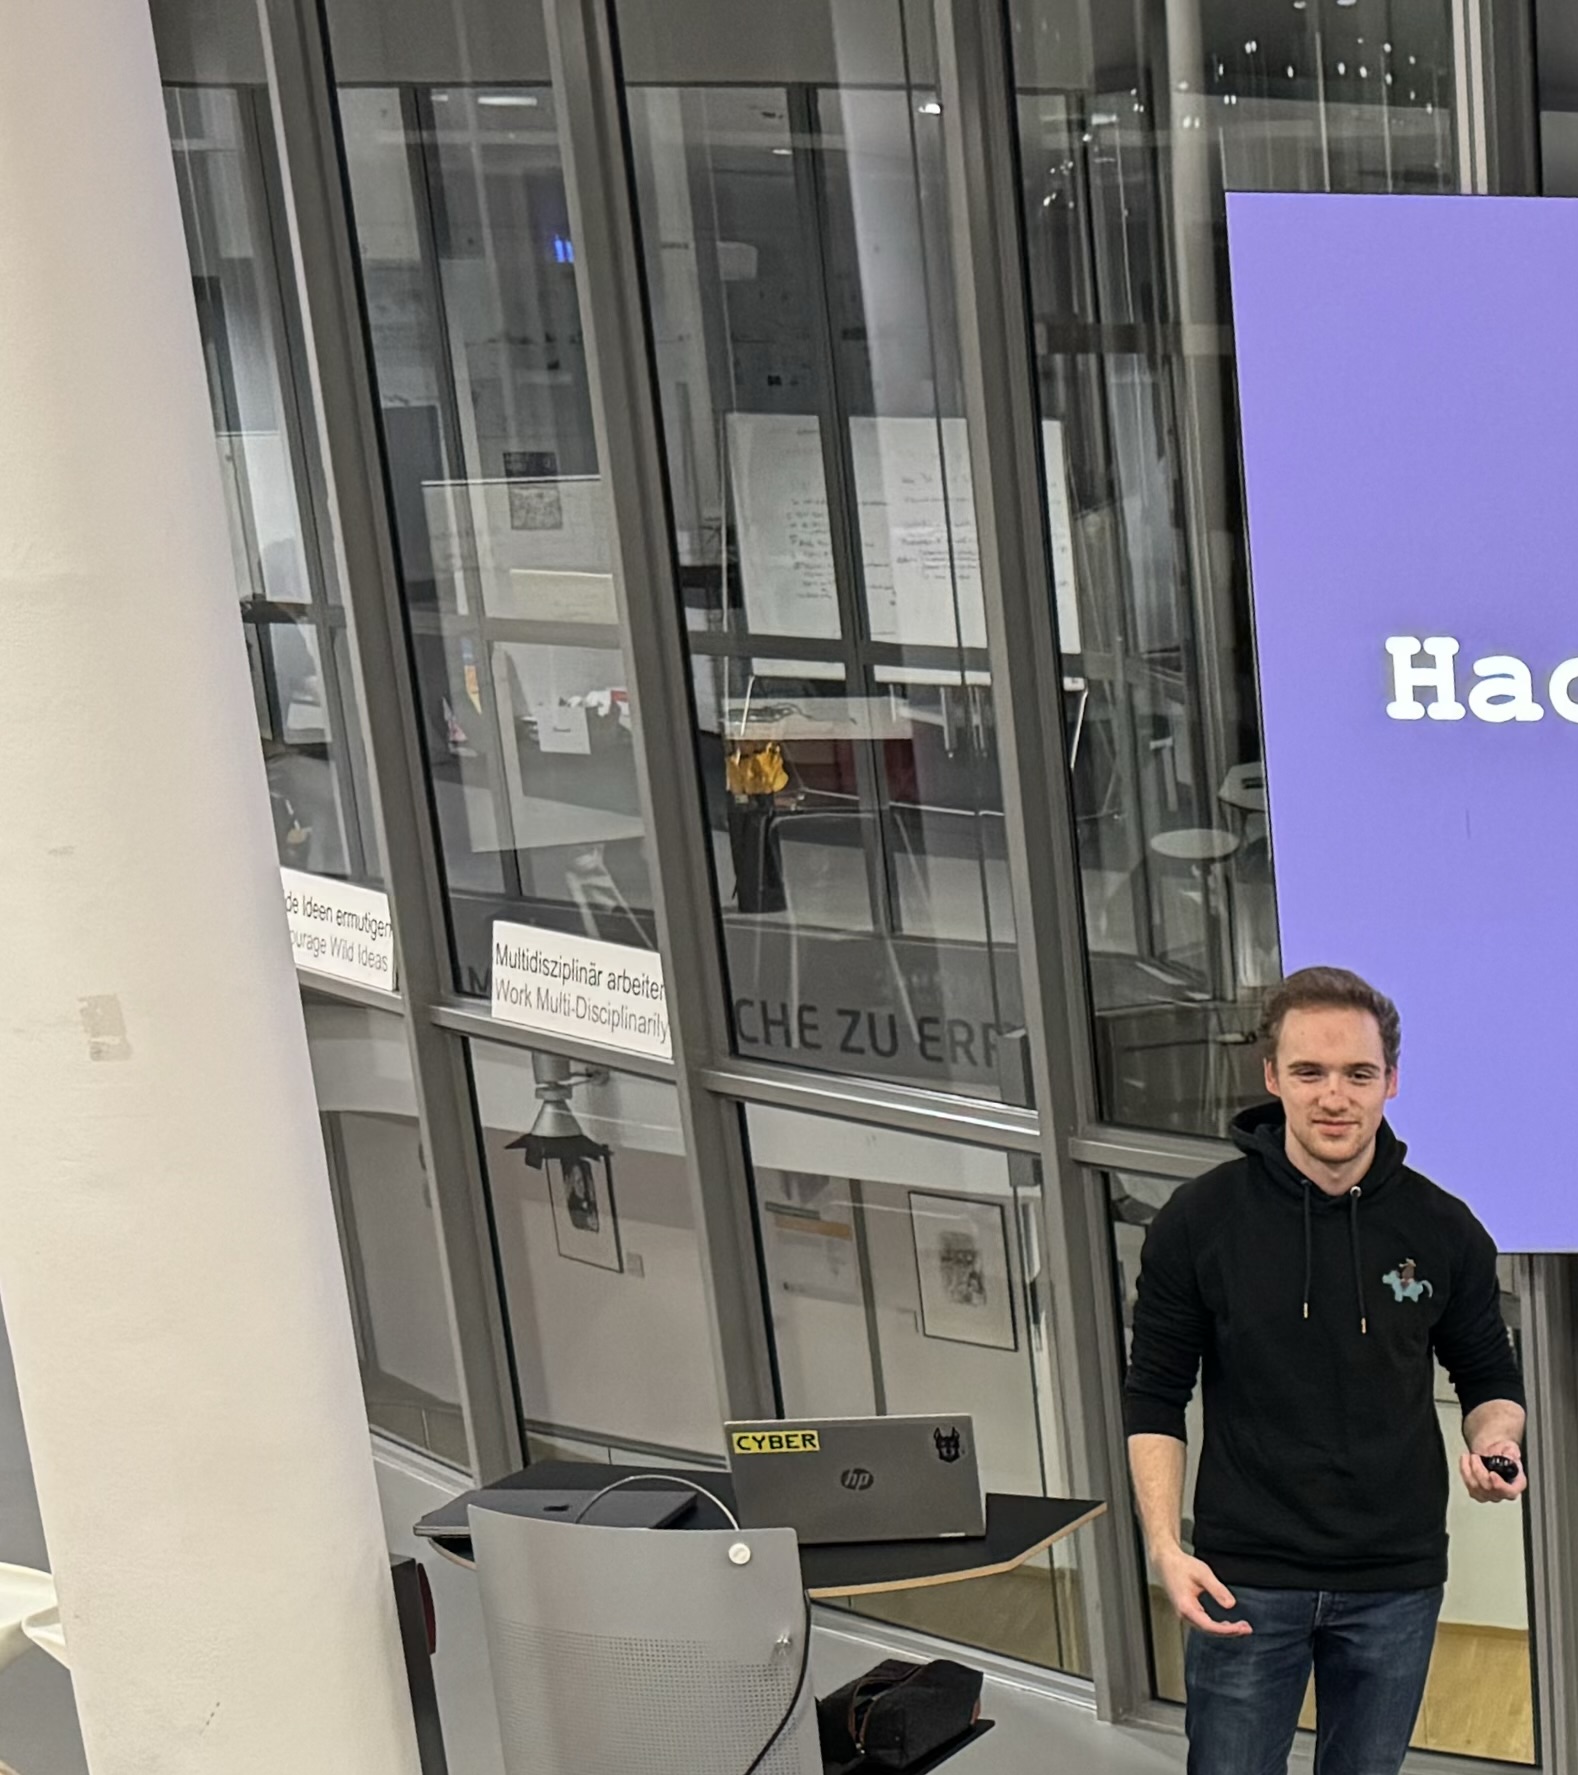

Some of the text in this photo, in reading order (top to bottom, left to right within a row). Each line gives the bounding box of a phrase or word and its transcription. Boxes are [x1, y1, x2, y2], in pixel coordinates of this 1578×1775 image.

[302, 895, 332, 923] Ideen
[336, 908, 392, 940] ermutigen
[330, 936, 354, 961] Wild
[358, 944, 388, 972] Ideas
[496, 943, 603, 986] Multidisziplinär
[495, 978, 532, 1008] Work
[536, 987, 669, 1044] Multi-Disciplinarily
[836, 1008, 899, 1058] ZU
[736, 1432, 818, 1451] CYBER
[843, 1468, 872, 1491] hp
